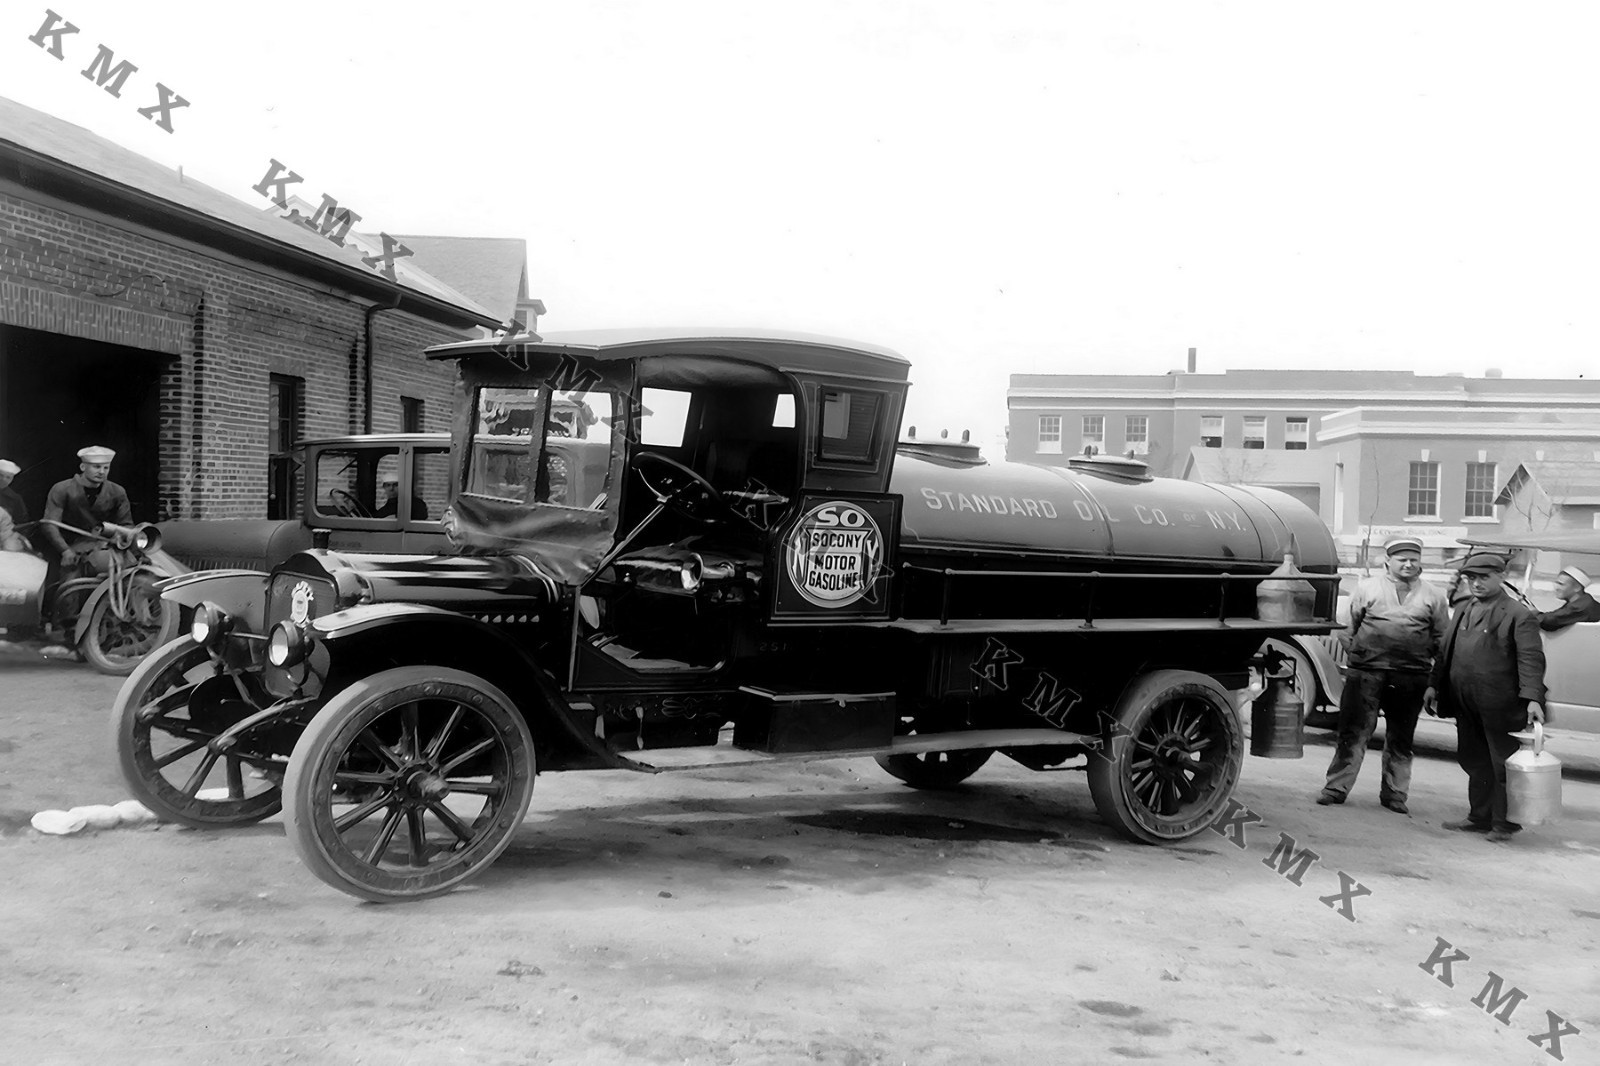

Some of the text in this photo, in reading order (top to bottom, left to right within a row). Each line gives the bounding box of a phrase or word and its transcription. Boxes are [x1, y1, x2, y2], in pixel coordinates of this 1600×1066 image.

[816, 506, 865, 527] SO
[920, 487, 1058, 519] STANDARD
[1073, 500, 1120, 522] OIL
[1133, 504, 1175, 526] CO.
[1204, 510, 1247, 531] N.Y.
[811, 532, 861, 548] SOCONY
[814, 555, 856, 570] MOTOR
[808, 570, 859, 591] GASOLINE
